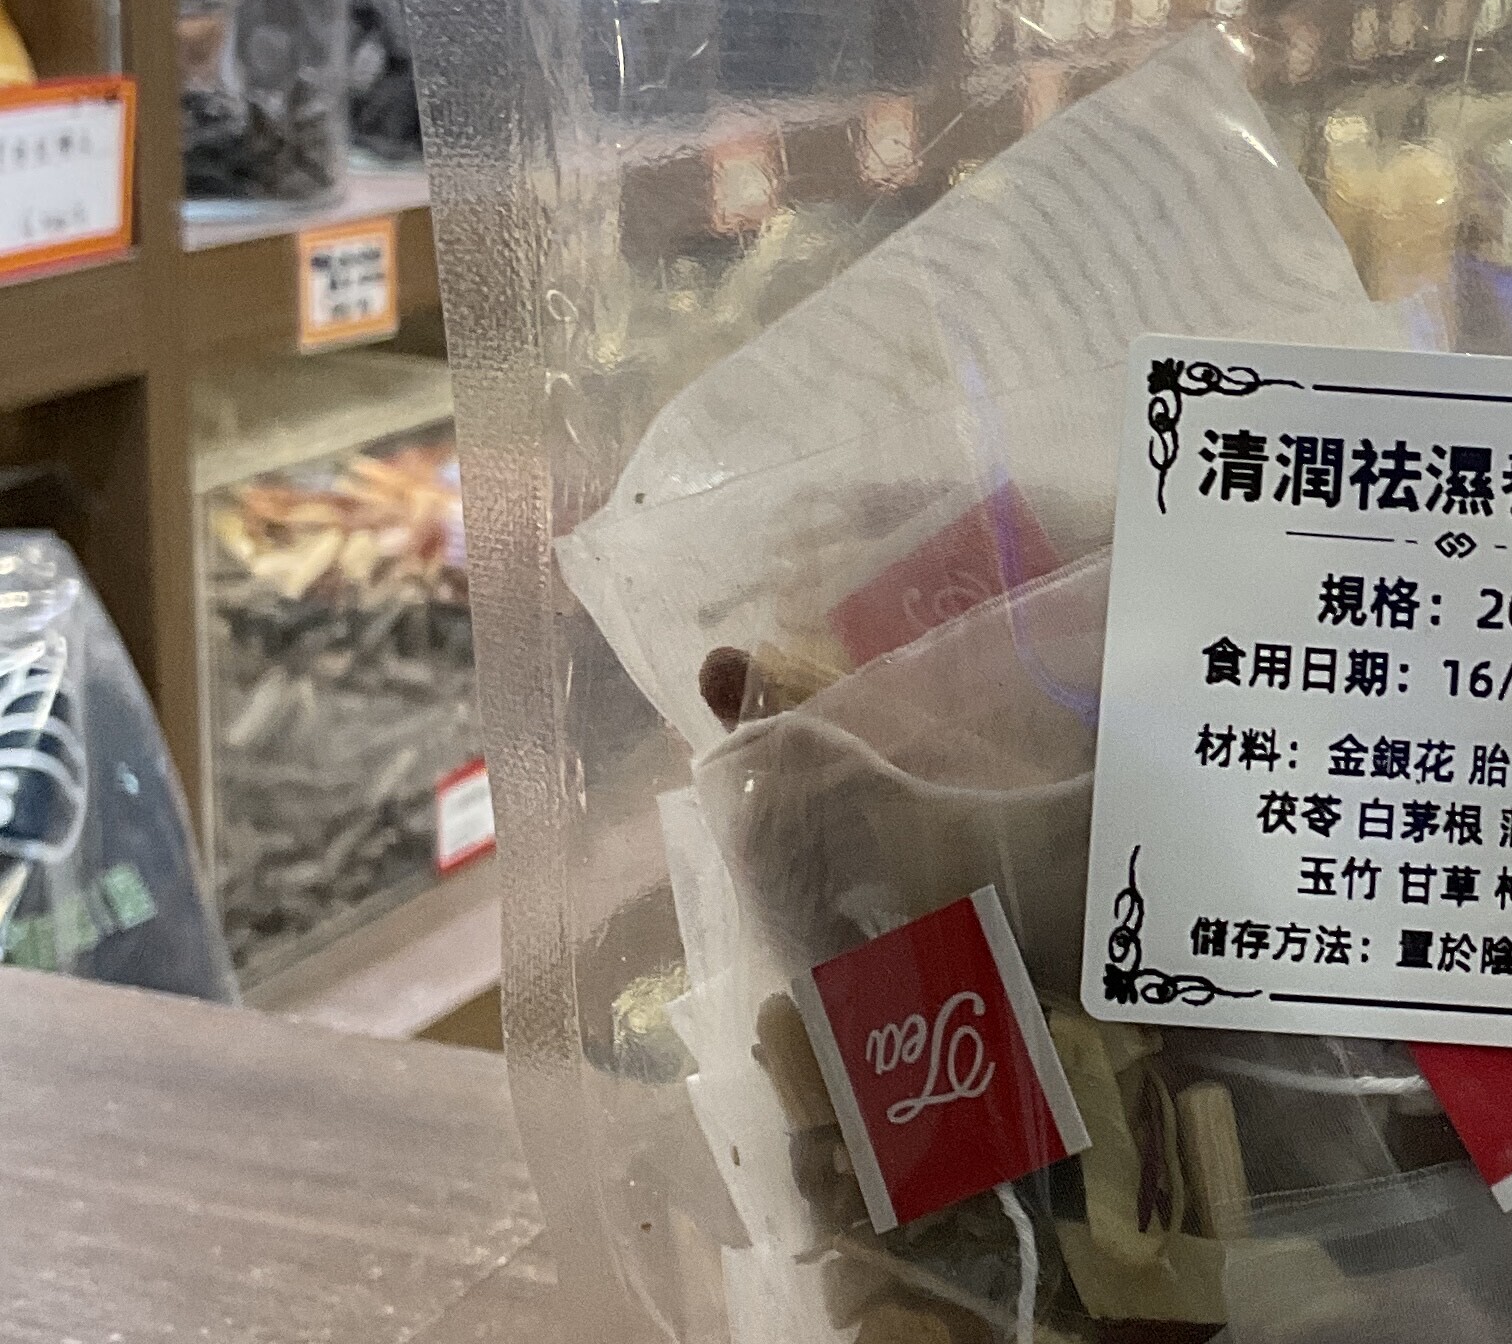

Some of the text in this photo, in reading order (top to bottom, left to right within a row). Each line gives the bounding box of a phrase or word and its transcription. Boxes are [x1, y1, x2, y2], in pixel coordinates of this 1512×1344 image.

[1328, 734, 1455, 784] 金銀花
[1257, 790, 1342, 837] 茯苓
[1359, 798, 1482, 845] 白茅根
[1297, 856, 1382, 900] 玉竹
[1399, 862, 1481, 907] 甘草
[864, 990, 995, 1124] Tea
